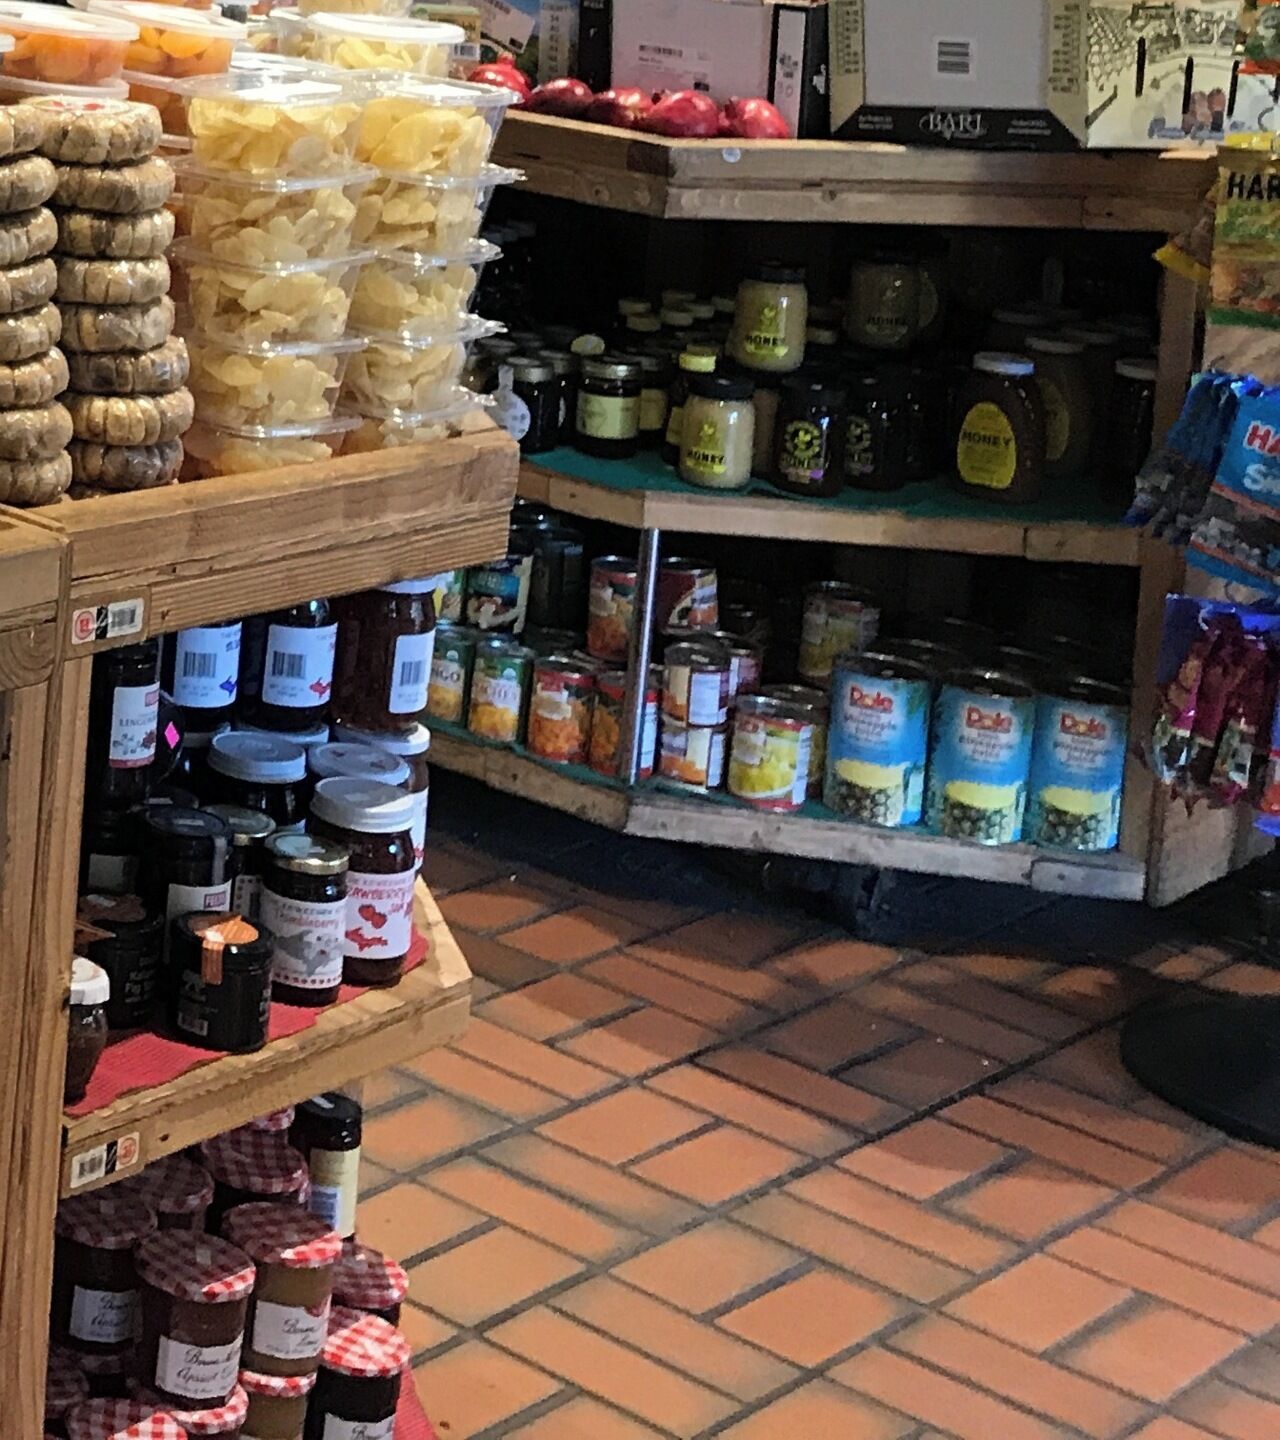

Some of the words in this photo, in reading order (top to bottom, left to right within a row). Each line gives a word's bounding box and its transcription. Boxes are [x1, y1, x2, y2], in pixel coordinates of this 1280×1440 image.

[962, 432, 1012, 447] HONEY
[849, 685, 894, 713] Dole
[965, 707, 1012, 733] Dole
[1060, 713, 1106, 739] Dole
